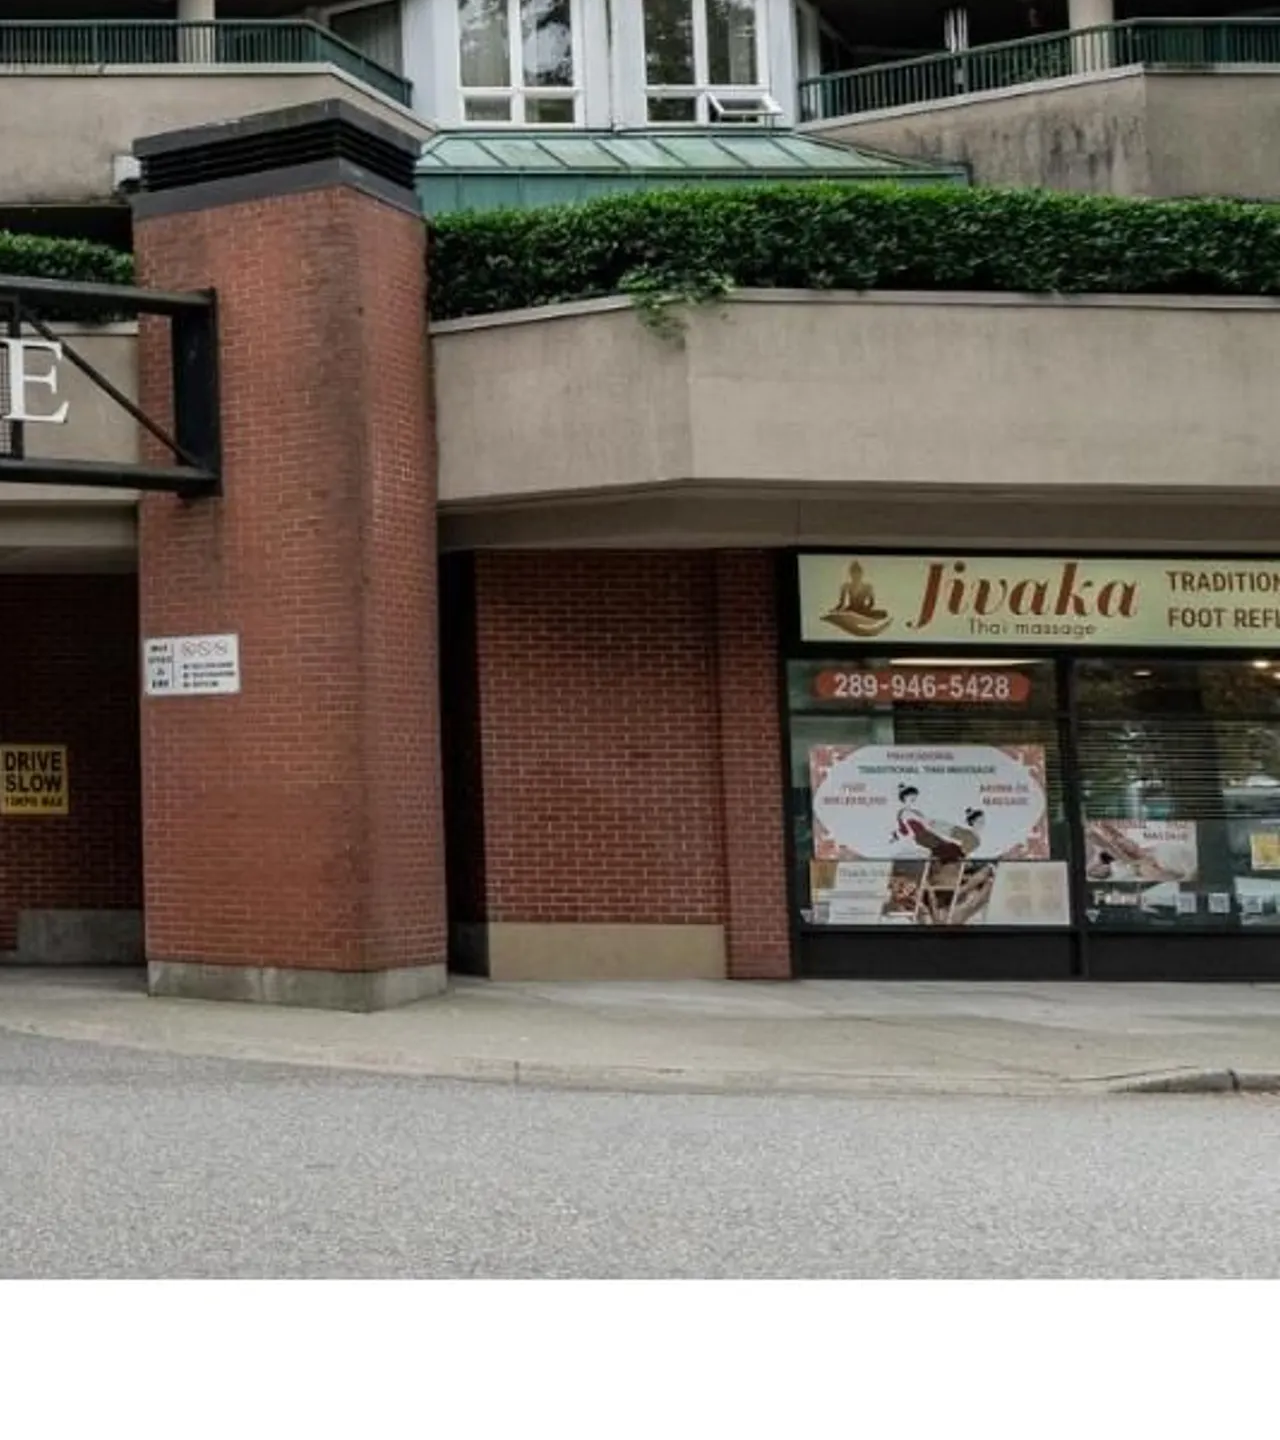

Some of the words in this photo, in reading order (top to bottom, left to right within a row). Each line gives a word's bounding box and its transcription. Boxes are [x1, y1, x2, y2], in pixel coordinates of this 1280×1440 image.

[906, 561, 1139, 631] Jivaka
[1167, 607, 1227, 629] FOOT
[1015, 621, 1097, 637] massage
[833, 673, 1011, 698] 289-946-5428
[5, 751, 62, 771] DRIVE
[5, 773, 62, 793] SLOW
